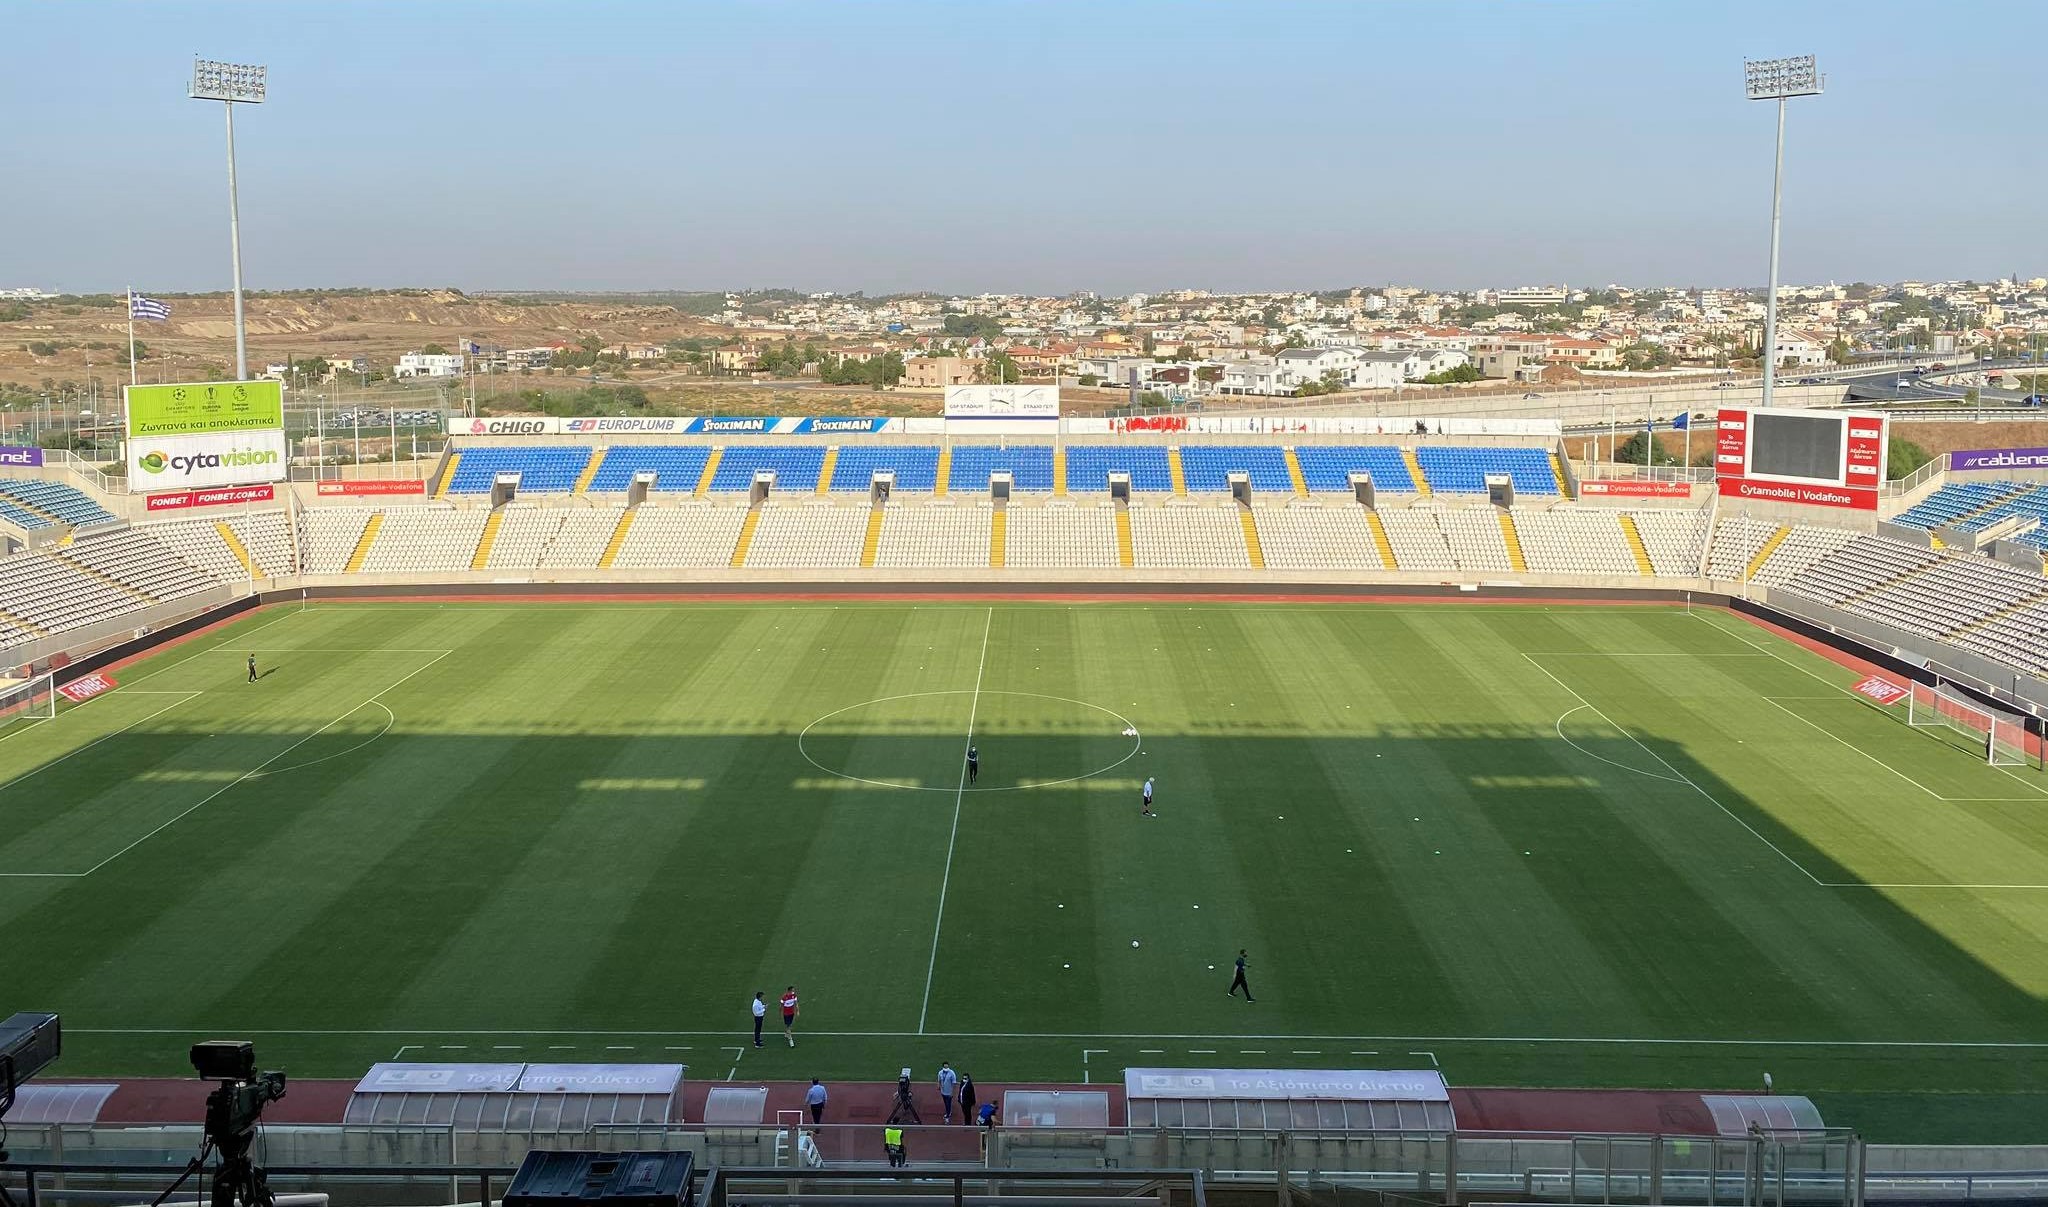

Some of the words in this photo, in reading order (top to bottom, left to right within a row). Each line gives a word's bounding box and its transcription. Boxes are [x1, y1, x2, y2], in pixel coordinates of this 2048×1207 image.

[140, 422, 187, 432] Ζωντανά
[190, 420, 206, 429] και
[209, 416, 274, 428] αποκλειστικά
[488, 421, 545, 433] CHIGO
[598, 420, 675, 431] EUROPLUMB
[171, 447, 278, 475] cytavision
[198, 489, 270, 503] FONBET.COM.CY
[1740, 484, 1796, 498] Cytamobile
[1803, 491, 1851, 504] Vodafone
[150, 496, 188, 507] FONBET
[1230, 1080, 1249, 1090] Το
[1255, 1079, 1352, 1092] Αξιόπιστο
[1359, 1081, 1425, 1091] Δίκτυο
